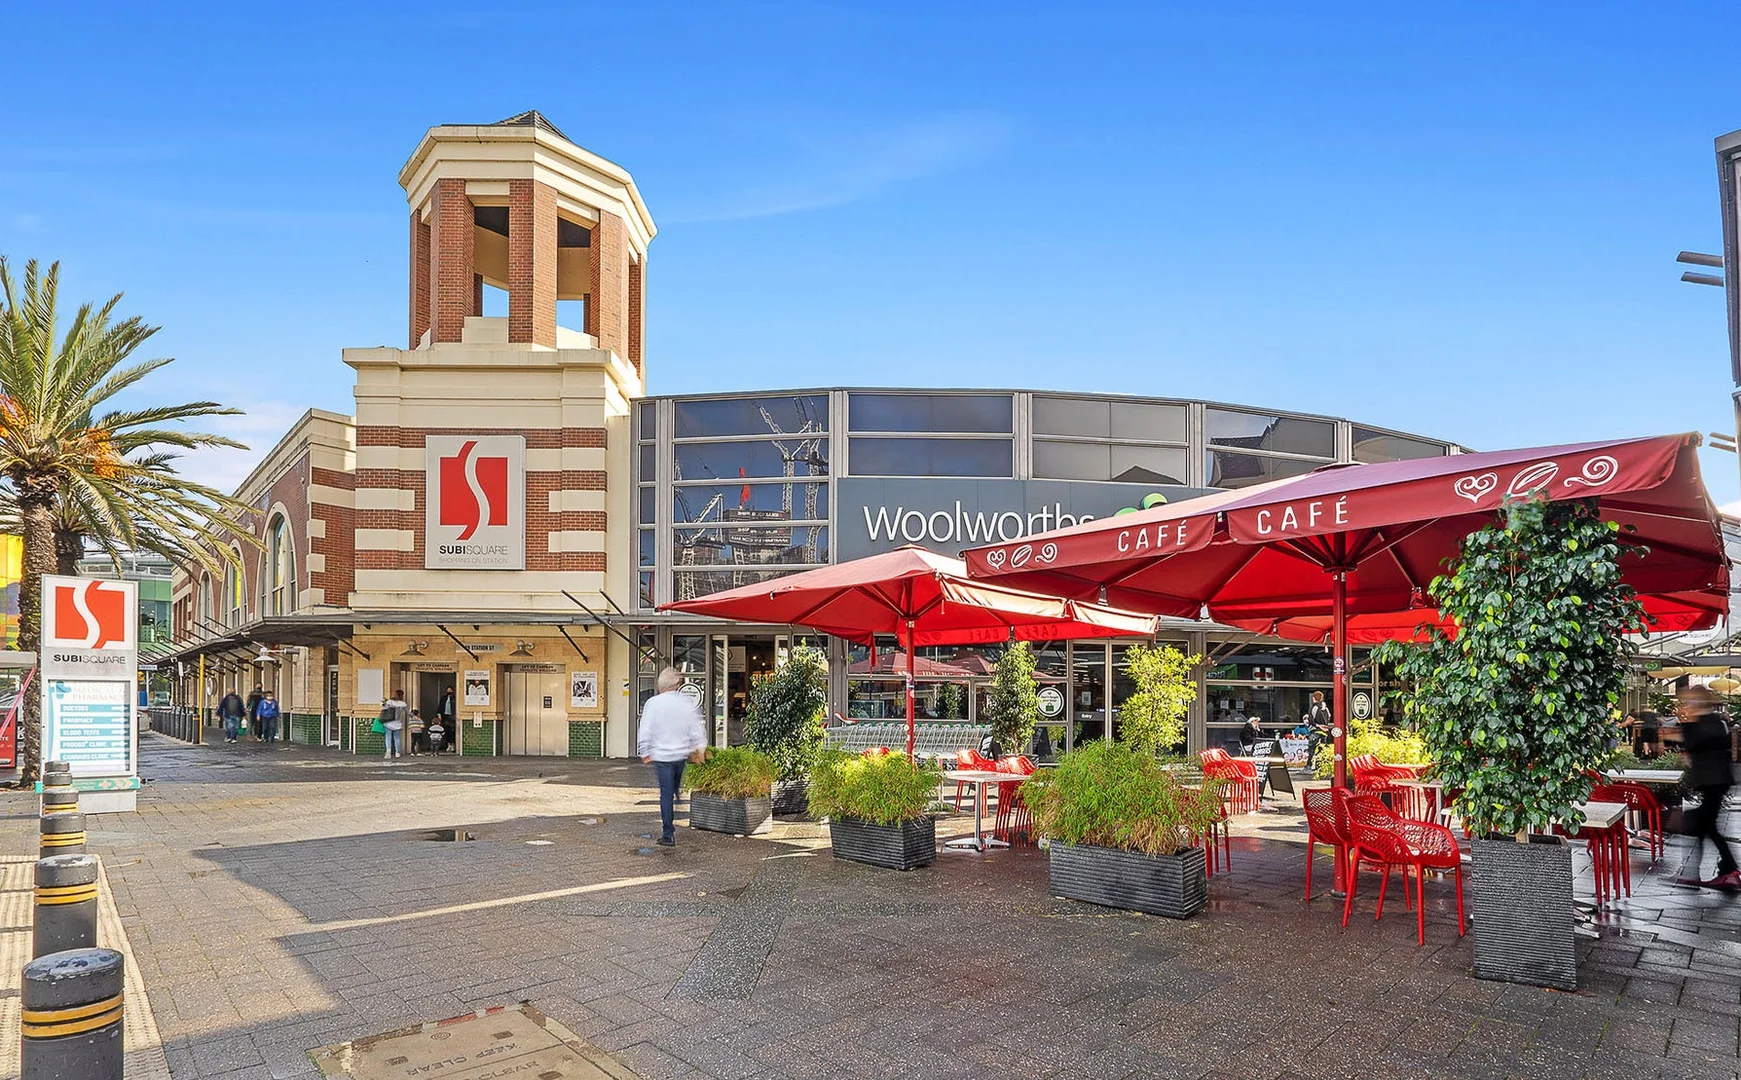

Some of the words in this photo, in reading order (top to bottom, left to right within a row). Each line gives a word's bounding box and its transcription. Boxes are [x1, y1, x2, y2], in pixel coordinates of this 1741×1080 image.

[1257, 496, 1349, 535] CAFÉ
[1117, 519, 1187, 553] CAFÉ
[439, 545, 508, 555] SUBISQUARE
[53, 654, 126, 665] SUBISQUARE
[407, 1056, 467, 1076] CLEAR
